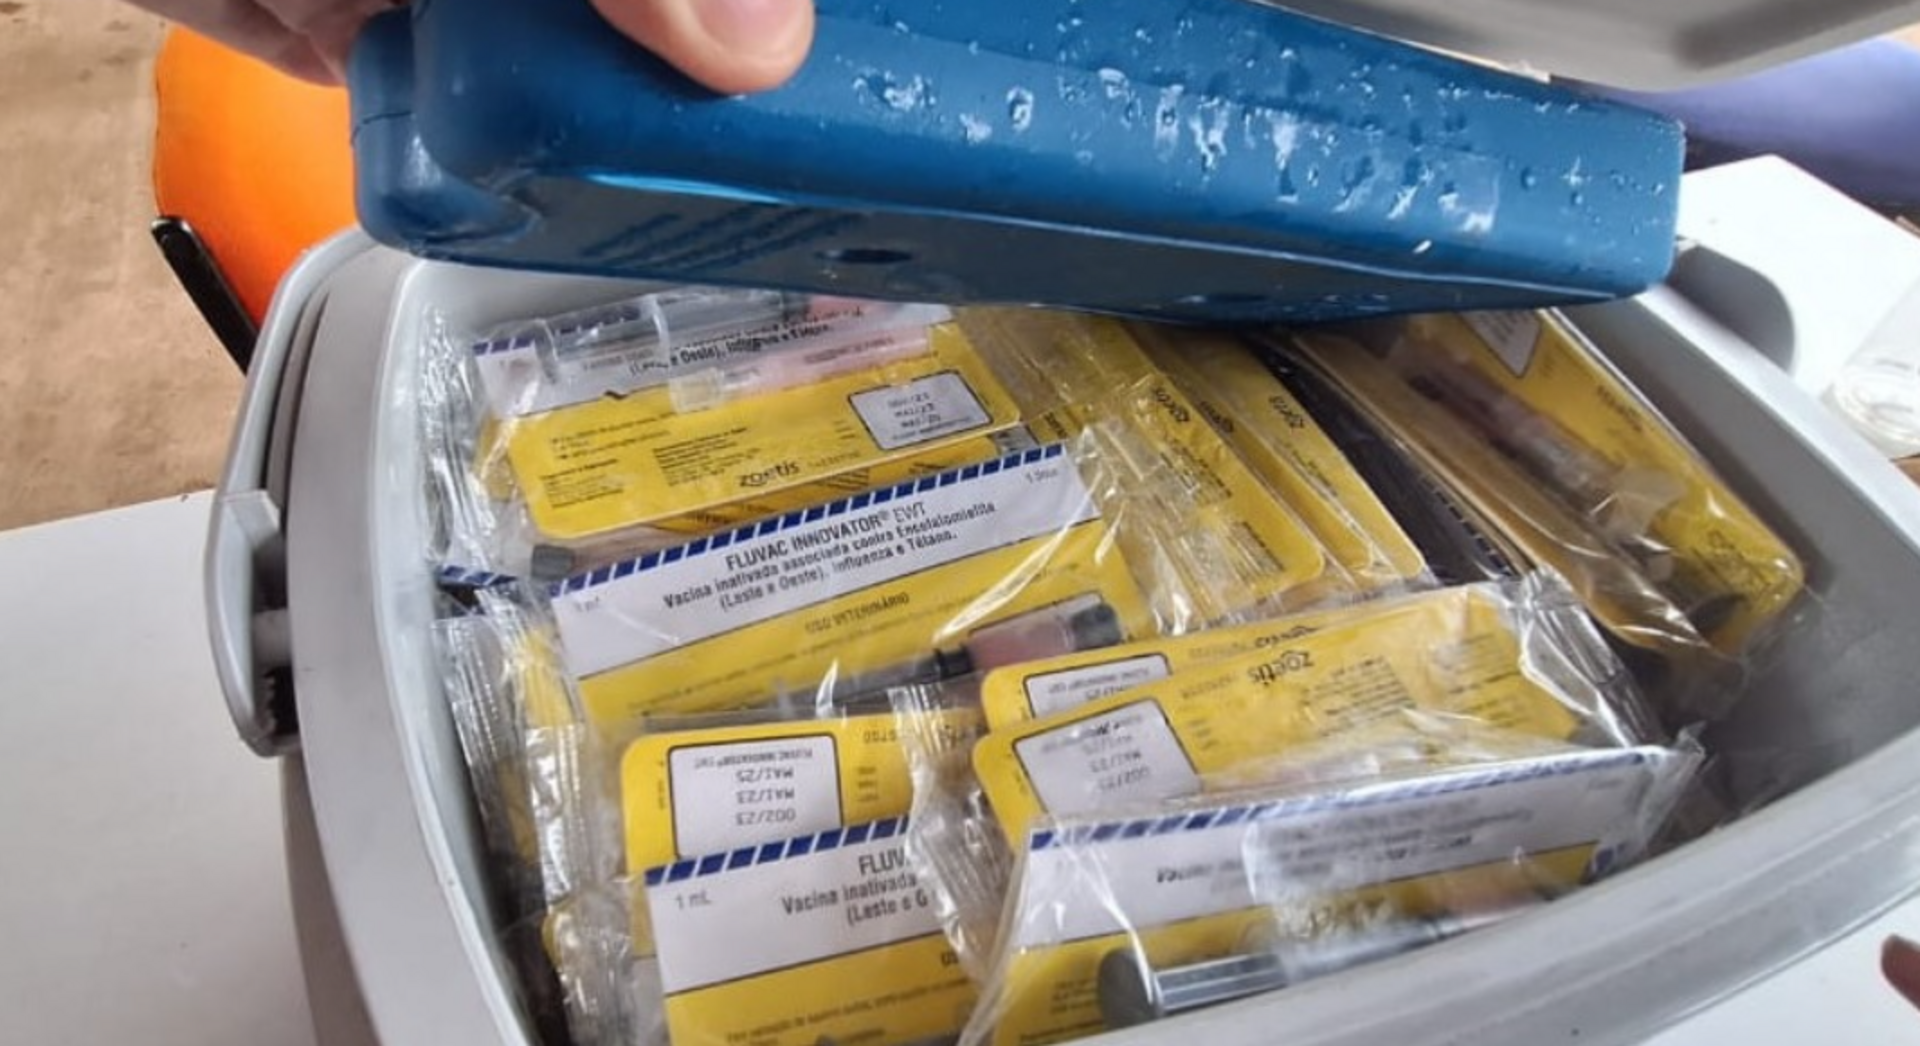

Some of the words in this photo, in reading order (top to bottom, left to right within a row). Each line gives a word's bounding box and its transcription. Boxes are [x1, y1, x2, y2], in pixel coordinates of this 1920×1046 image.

[725, 540, 790, 571] FLUVAC
[892, 500, 928, 522] EWT
[662, 584, 713, 609] Vacina
[715, 558, 779, 591] inativada
[782, 543, 850, 574] associada
[853, 526, 897, 550] contra
[832, 546, 894, 573] Influenza
[897, 544, 906, 556] e
[735, 787, 795, 804] MAI/23
[858, 844, 911, 877] FLUV
[781, 888, 839, 916] Vacina
[843, 875, 918, 902] inativada
[846, 896, 900, 927] (Leste
[902, 894, 912, 912] e
